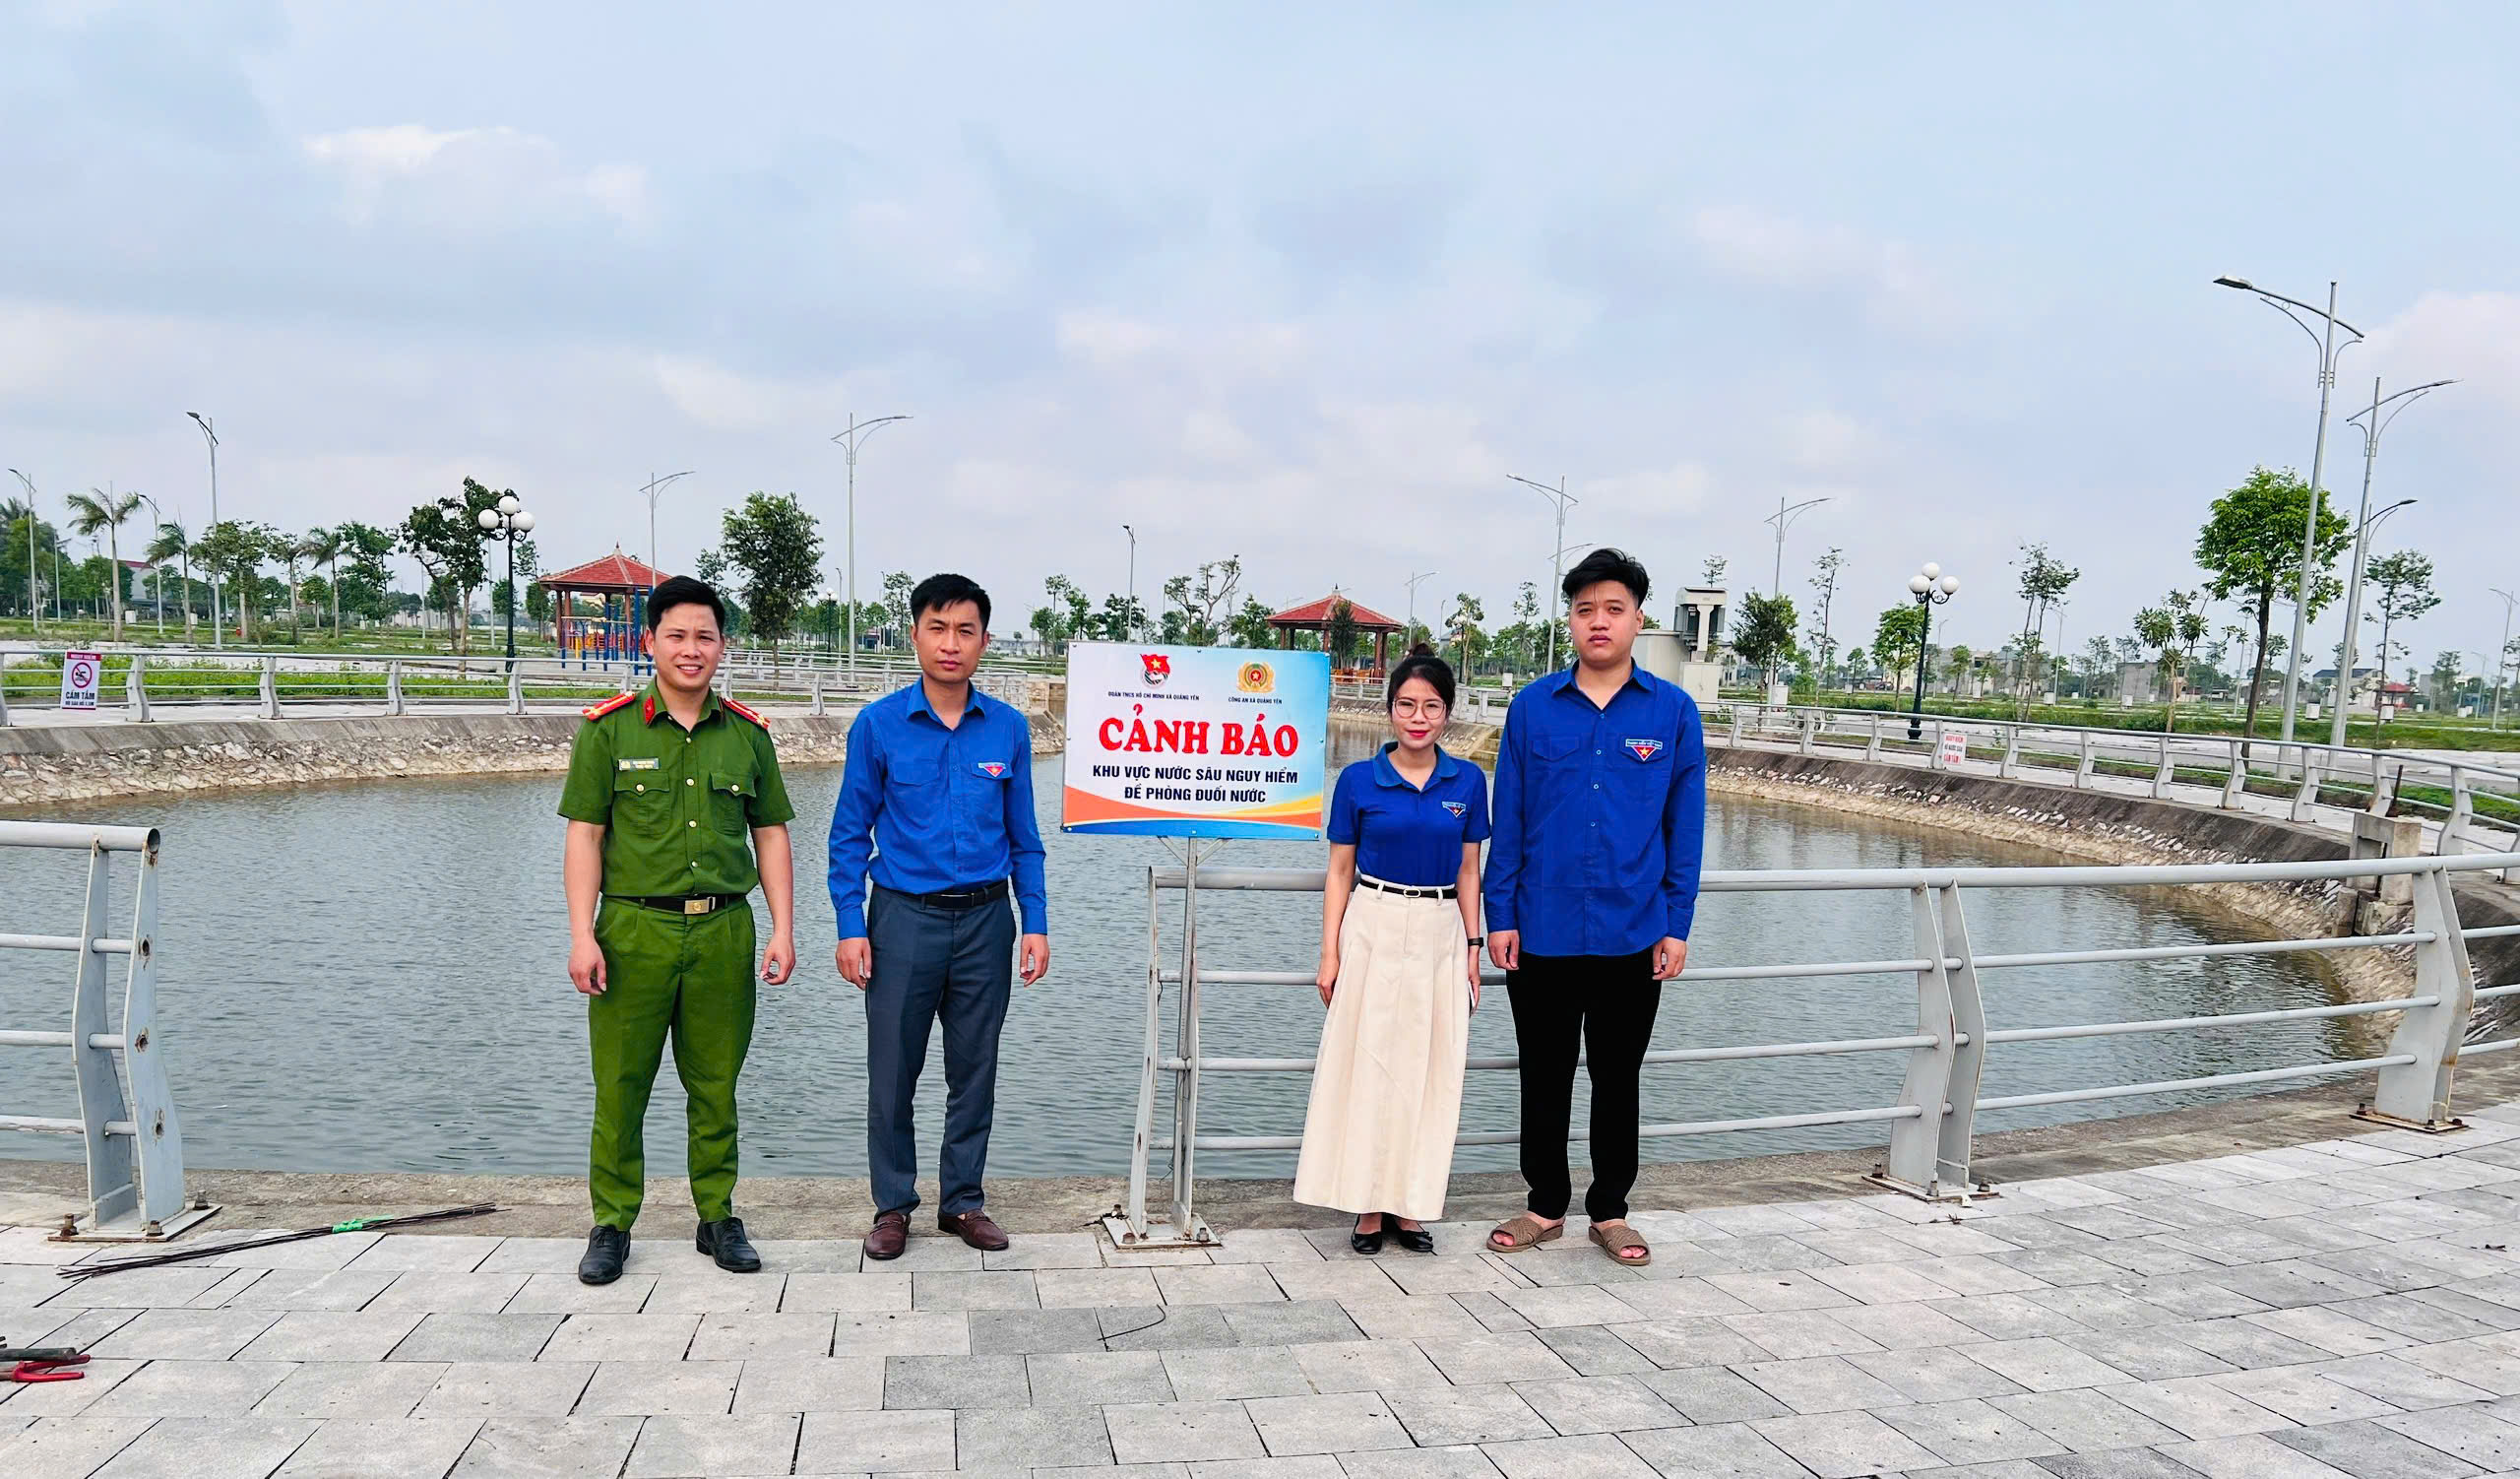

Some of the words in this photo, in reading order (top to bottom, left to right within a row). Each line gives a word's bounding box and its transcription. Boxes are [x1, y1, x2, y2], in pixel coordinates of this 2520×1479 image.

[1099, 703, 1210, 754] CẢNH
[1221, 713, 1299, 757] BÁO
[1093, 764, 1120, 778] KHU
[1124, 765, 1151, 781] VỰC
[1155, 765, 1191, 780] NƯỚC
[1196, 767, 1222, 781] SÂU
[1226, 769, 1261, 783] NGUY
[1265, 766, 1298, 784] HIỂM
[1124, 783, 1142, 799] ĐỀ
[1146, 784, 1191, 801] PHÒNG
[1195, 785, 1227, 802] ĐUỐI
[1230, 788, 1266, 803] NƯỚC
